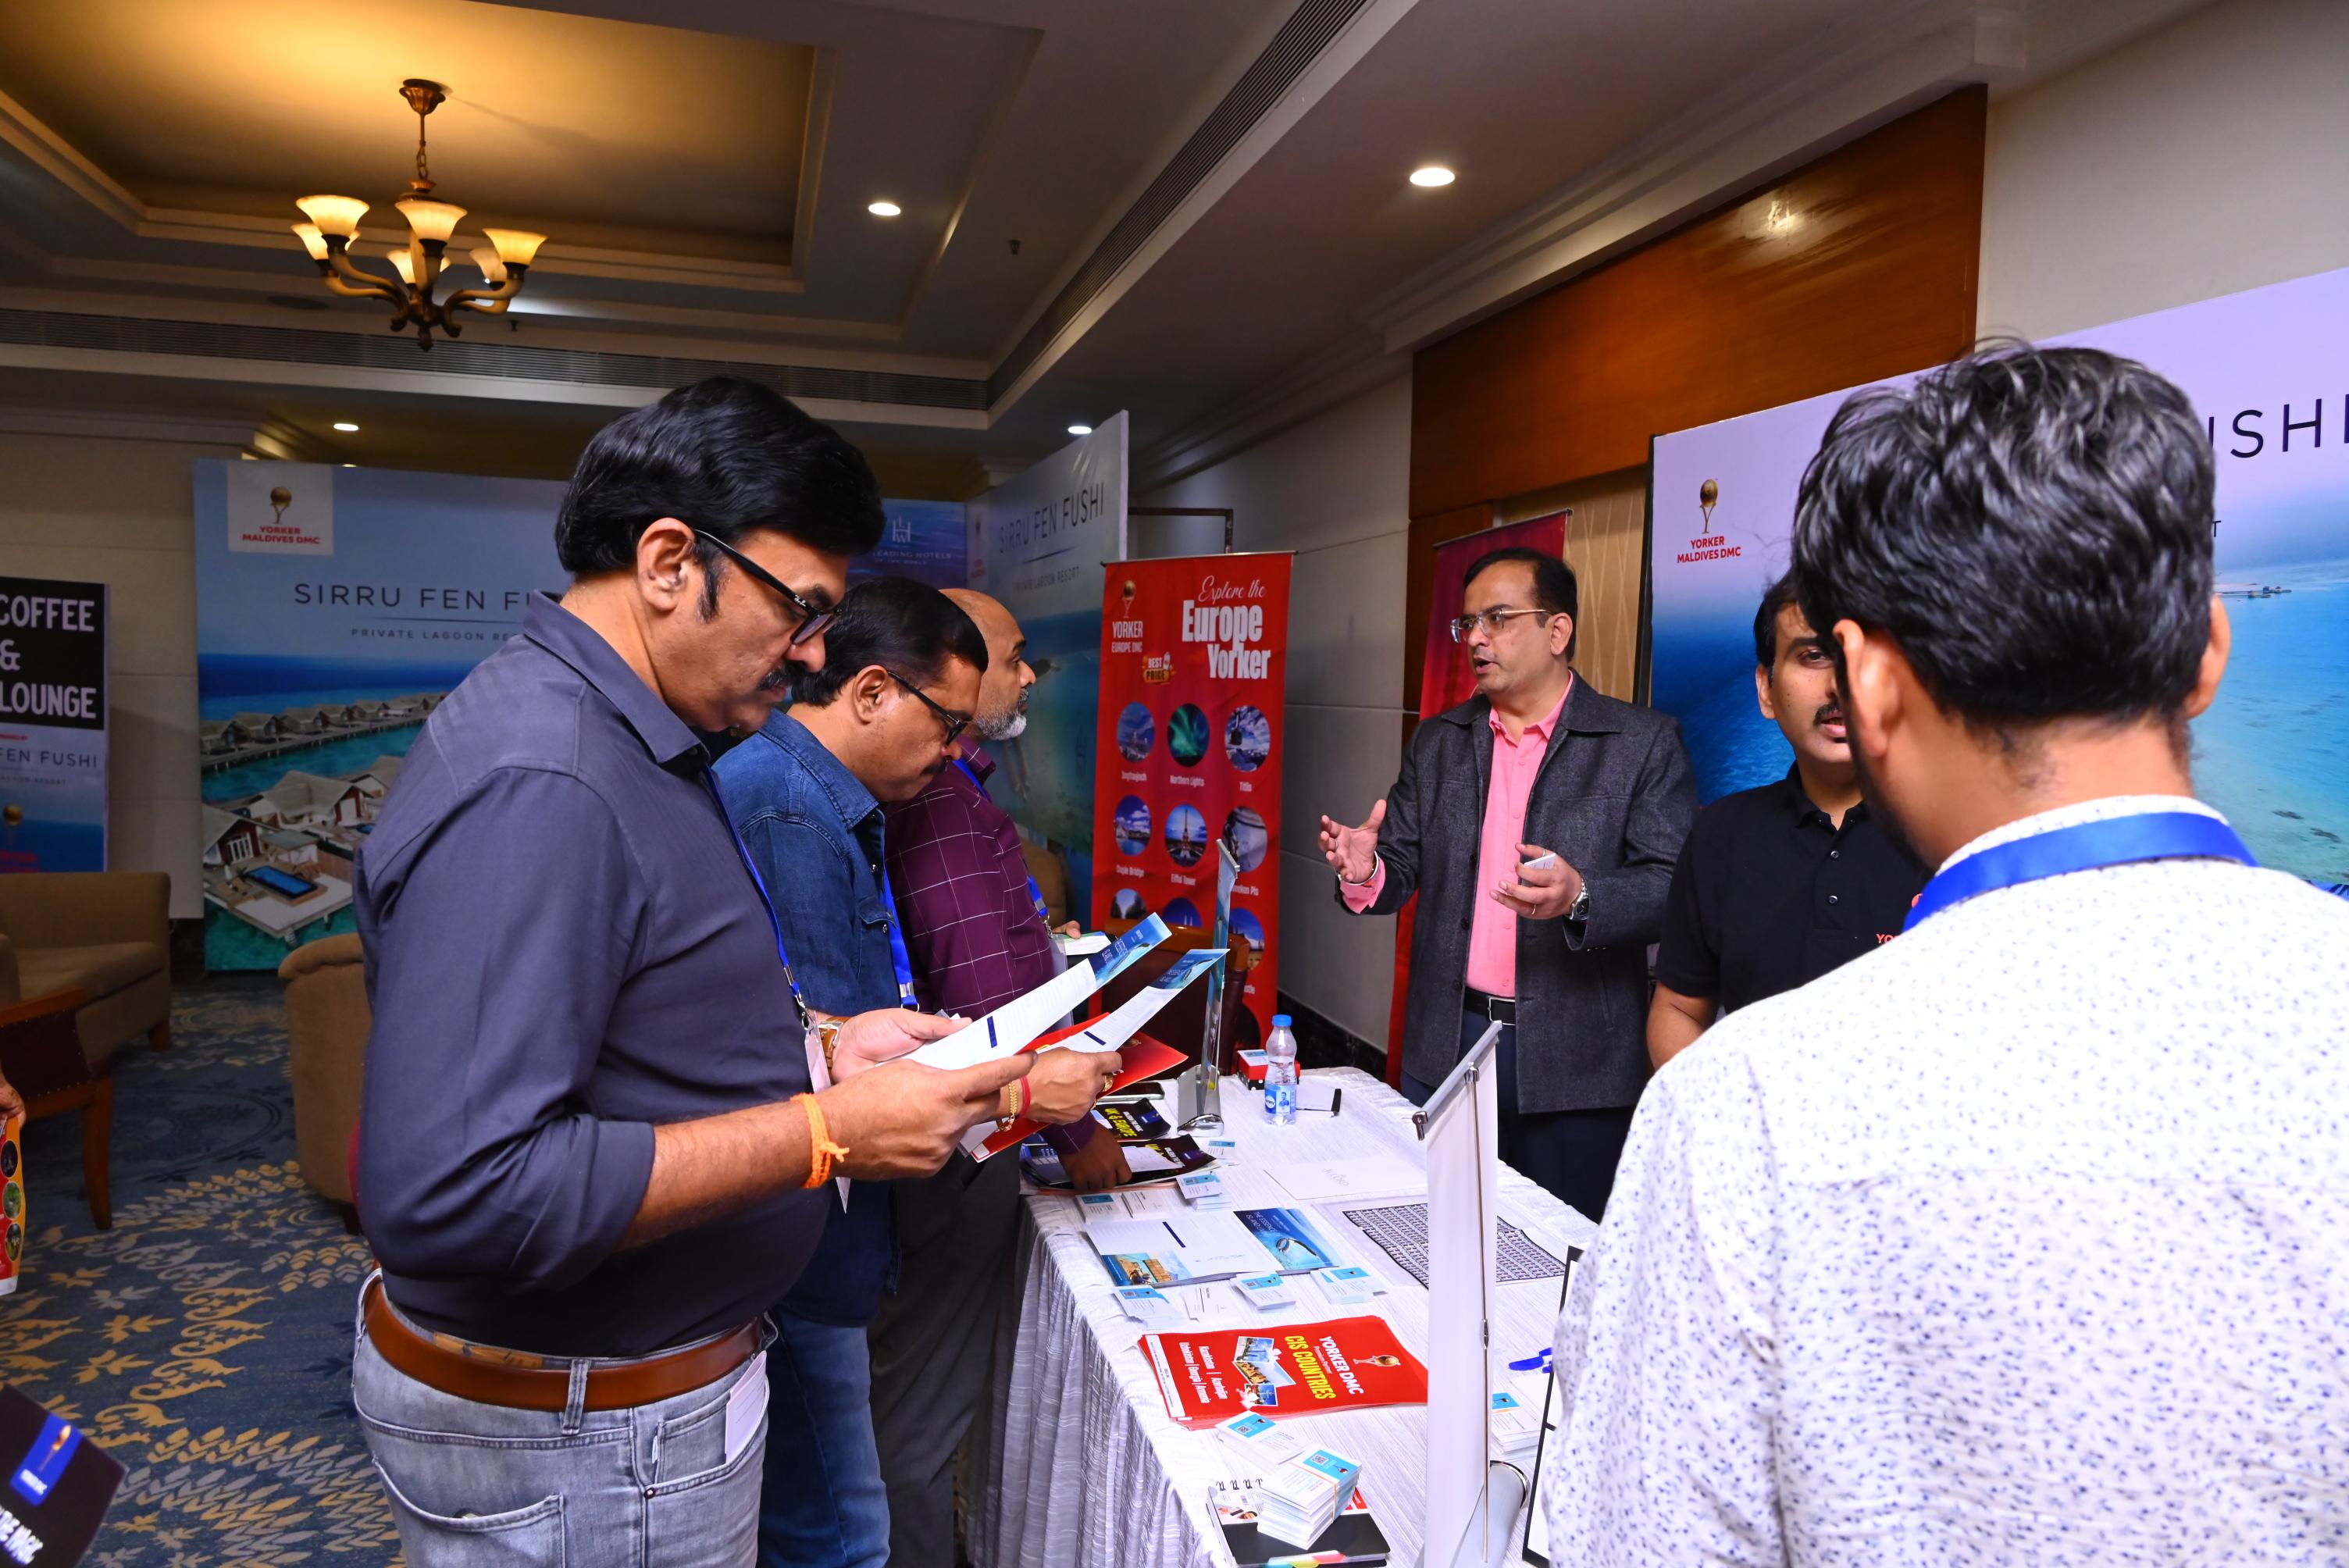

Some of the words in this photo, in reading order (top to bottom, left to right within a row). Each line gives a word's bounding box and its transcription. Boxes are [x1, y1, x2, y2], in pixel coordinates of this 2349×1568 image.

[999, 516, 1030, 554] SIRRU
[1034, 503, 1057, 540] FEN
[1063, 481, 1103, 529] FUSHI
[242, 533, 294, 543] MALDIVES
[296, 536, 321, 544] DMC
[259, 526, 301, 535] YORKER
[1690, 536, 1725, 549] YORKER
[914, 551, 952, 560] HOTELS
[1677, 549, 1719, 563] MALDIVES
[1720, 547, 1741, 558] DMC
[294, 583, 401, 608] SIRRU
[420, 587, 485, 611] FEN
[1198, 575, 1244, 604] Explore
[1248, 579, 1266, 599] the
[1112, 621, 1143, 638] YORKER
[1182, 599, 1263, 650] Europe
[351, 629, 414, 639] PRIVATE
[422, 631, 484, 641] LAGOON
[0, 640, 20, 671] &
[1112, 642, 1132, 653] EUROPE
[1147, 657, 1163, 668] BEST
[1207, 643, 1271, 679] Yorker
[1146, 669, 1166, 681] PRICE
[0, 681, 96, 718] LOUNGE
[41, 751, 98, 768] FUSHI
[1114, 1119, 1138, 1138] EUROPE
[1285, 1335, 1309, 1350] CIS
[1319, 1335, 1350, 1372] YORKER
[1338, 1372, 1364, 1395] DMC
[1292, 1351, 1337, 1399] COUNTRIES
